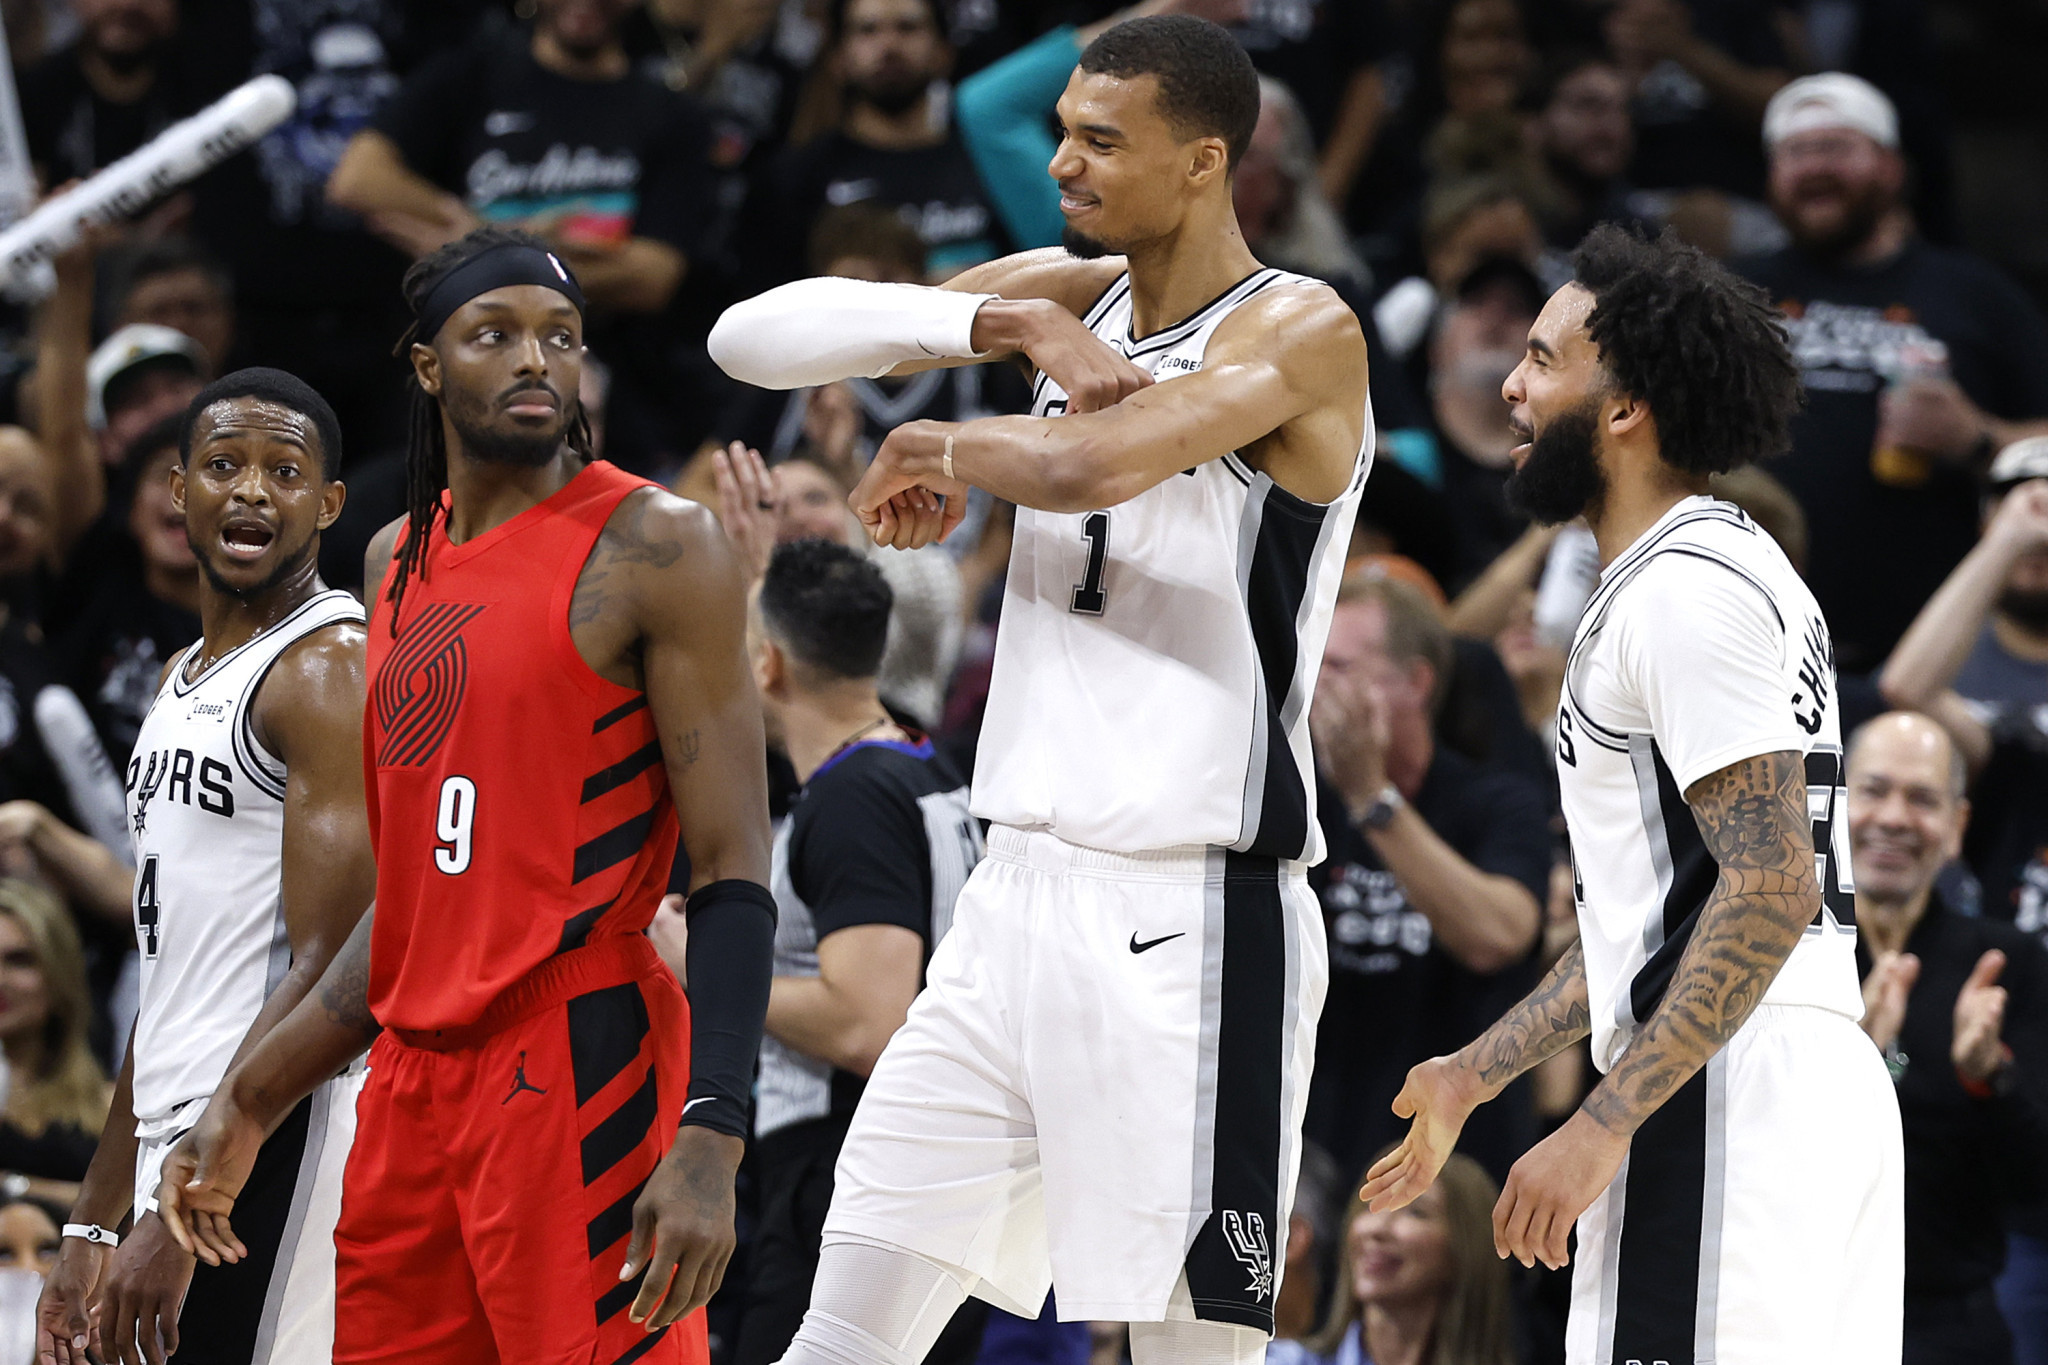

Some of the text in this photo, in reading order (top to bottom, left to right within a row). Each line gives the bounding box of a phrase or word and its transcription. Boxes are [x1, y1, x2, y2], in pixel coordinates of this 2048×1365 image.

[1069, 510, 1111, 617] 1
[193, 703, 224, 716] LEDGER
[433, 774, 478, 876] 9
[138, 853, 161, 961] 4
